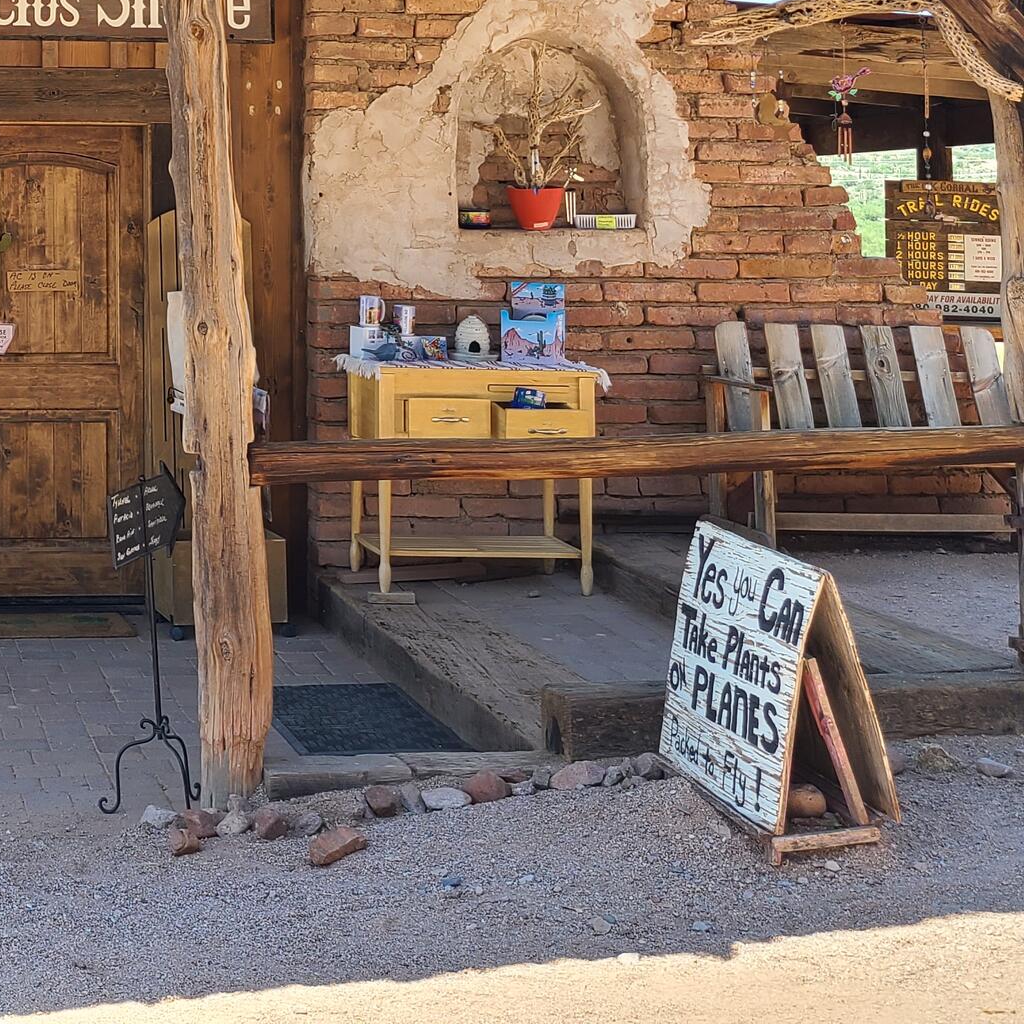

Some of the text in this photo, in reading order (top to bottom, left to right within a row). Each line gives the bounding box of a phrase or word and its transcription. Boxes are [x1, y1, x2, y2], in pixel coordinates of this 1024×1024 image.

[940, 183, 978, 192] CORRAL
[897, 195, 999, 221] TRAL RIDES
[908, 232, 936, 240] HOUR
[908, 241, 936, 251] HOUR
[896, 251, 902, 259] 2
[908, 251, 944, 260] HOURS
[908, 261, 944, 270] HOURS
[908, 270, 944, 279] HOURS
[956, 296, 1000, 304] AVAILABILIT
[935, 304, 994, 314] 982-4040
[694, 533, 728, 610] Yes
[728, 566, 757, 616] you
[722, 625, 781, 695] Plants
[691, 665, 779, 754] PLANES
[670, 716, 701, 766] Packed
[702, 744, 714, 776] to
